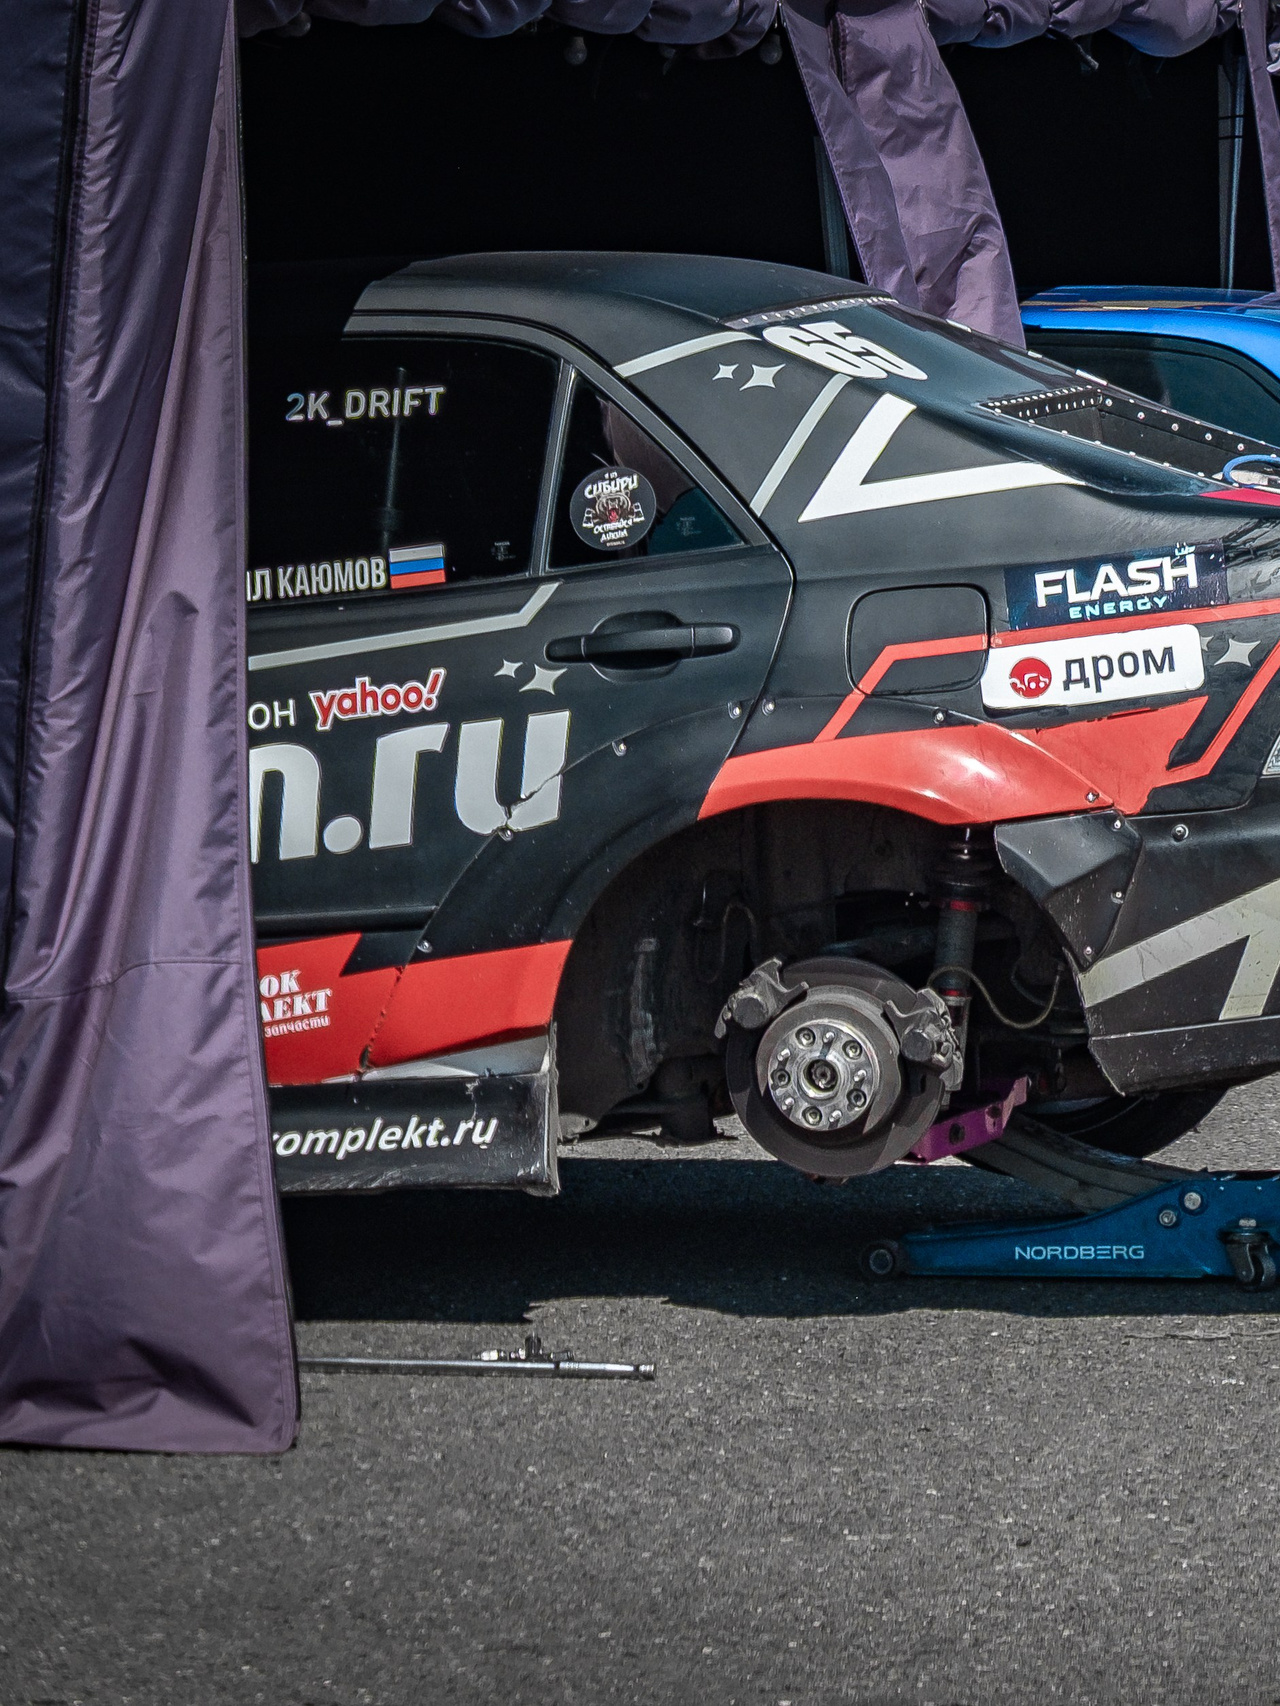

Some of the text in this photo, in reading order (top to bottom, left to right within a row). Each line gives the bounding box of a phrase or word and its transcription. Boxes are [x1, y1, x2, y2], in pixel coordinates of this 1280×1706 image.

[762, 320, 929, 380] 65
[286, 386, 446, 426] 2K_DRIFT
[584, 474, 639, 499] СИБИРИ
[277, 556, 387, 599] КАЮМОВ
[1034, 553, 1199, 608] FLASH
[1068, 595, 1168, 619] ENERGY
[1063, 645, 1176, 693] дром
[309, 668, 446, 731] yahoo!
[273, 1115, 499, 1160] omplekt.ru
[1015, 1245, 1145, 1261] NORDBERG
